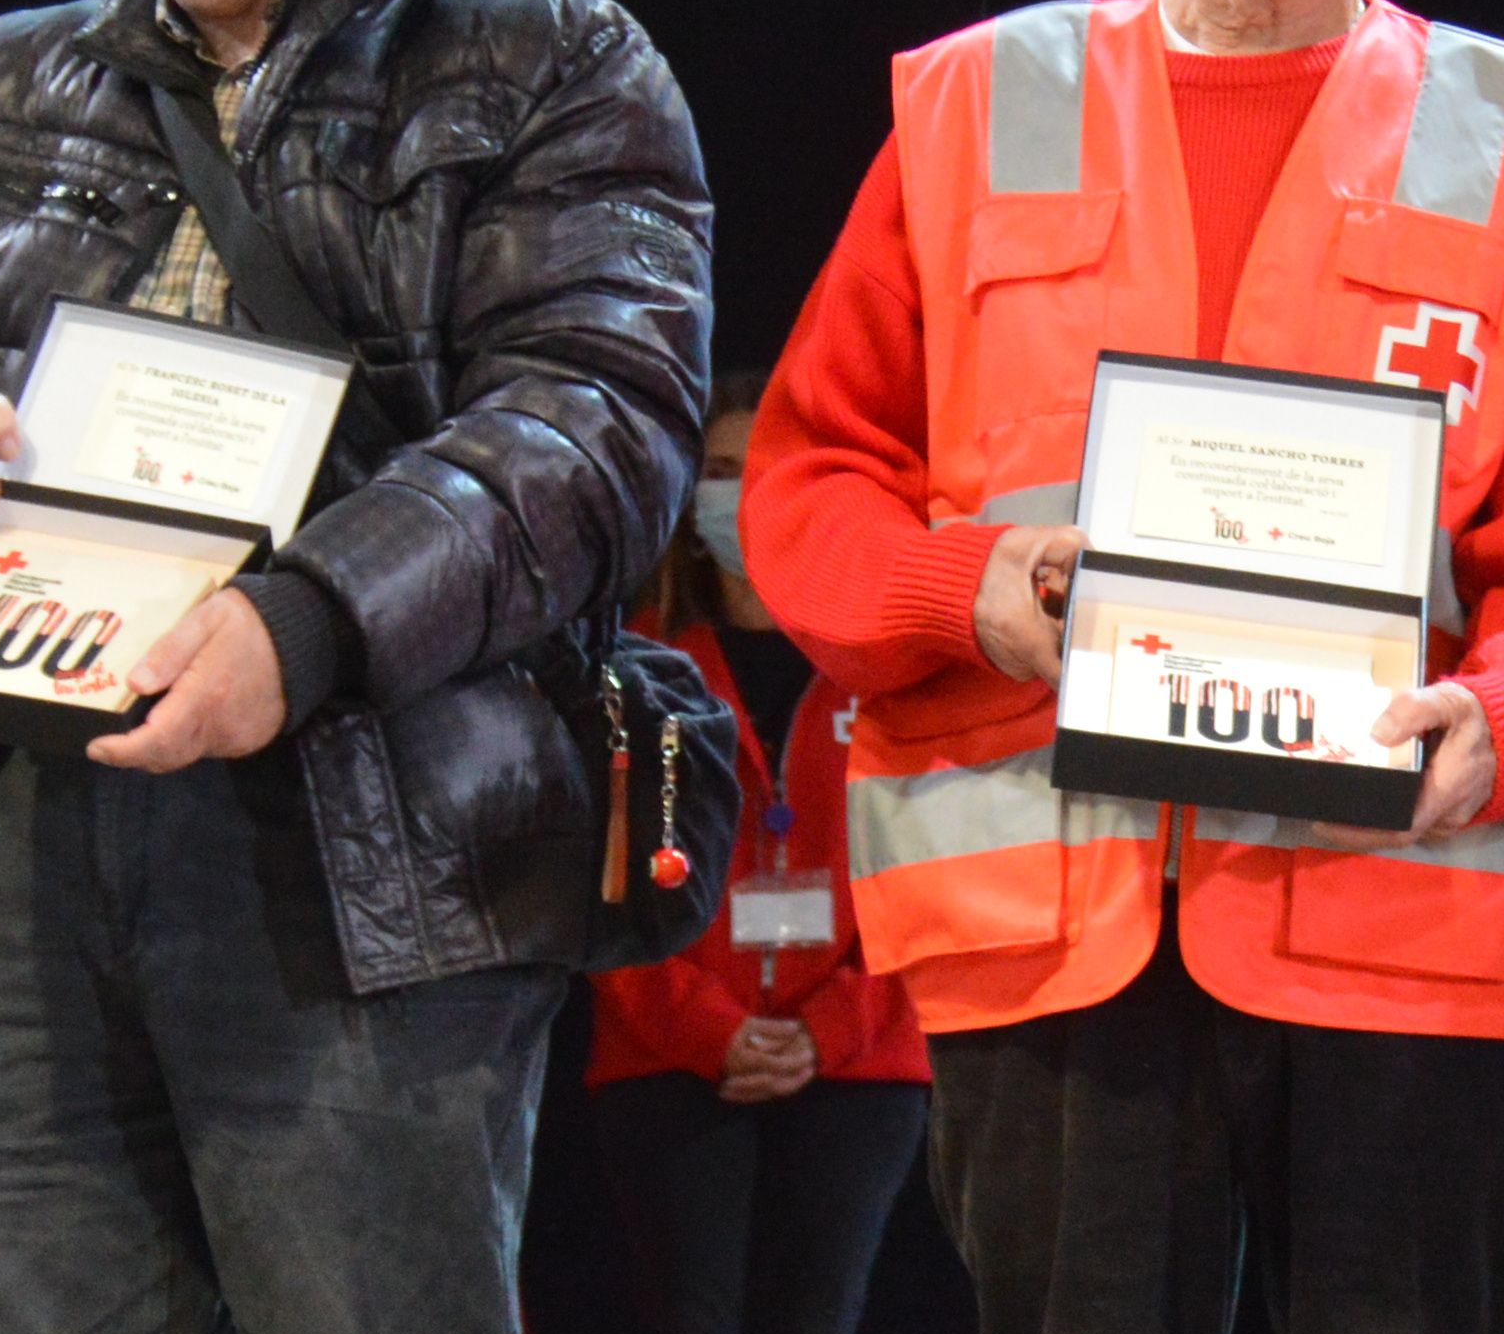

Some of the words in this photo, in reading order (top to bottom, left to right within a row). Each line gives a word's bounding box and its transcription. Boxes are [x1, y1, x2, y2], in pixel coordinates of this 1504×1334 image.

[1190, 438, 1245, 453] MIQUEL
[1249, 445, 1307, 461] SANCHO
[1310, 453, 1365, 469] TORRES
[1214, 517, 1245, 541] 100
[1159, 672, 1315, 752] 100
